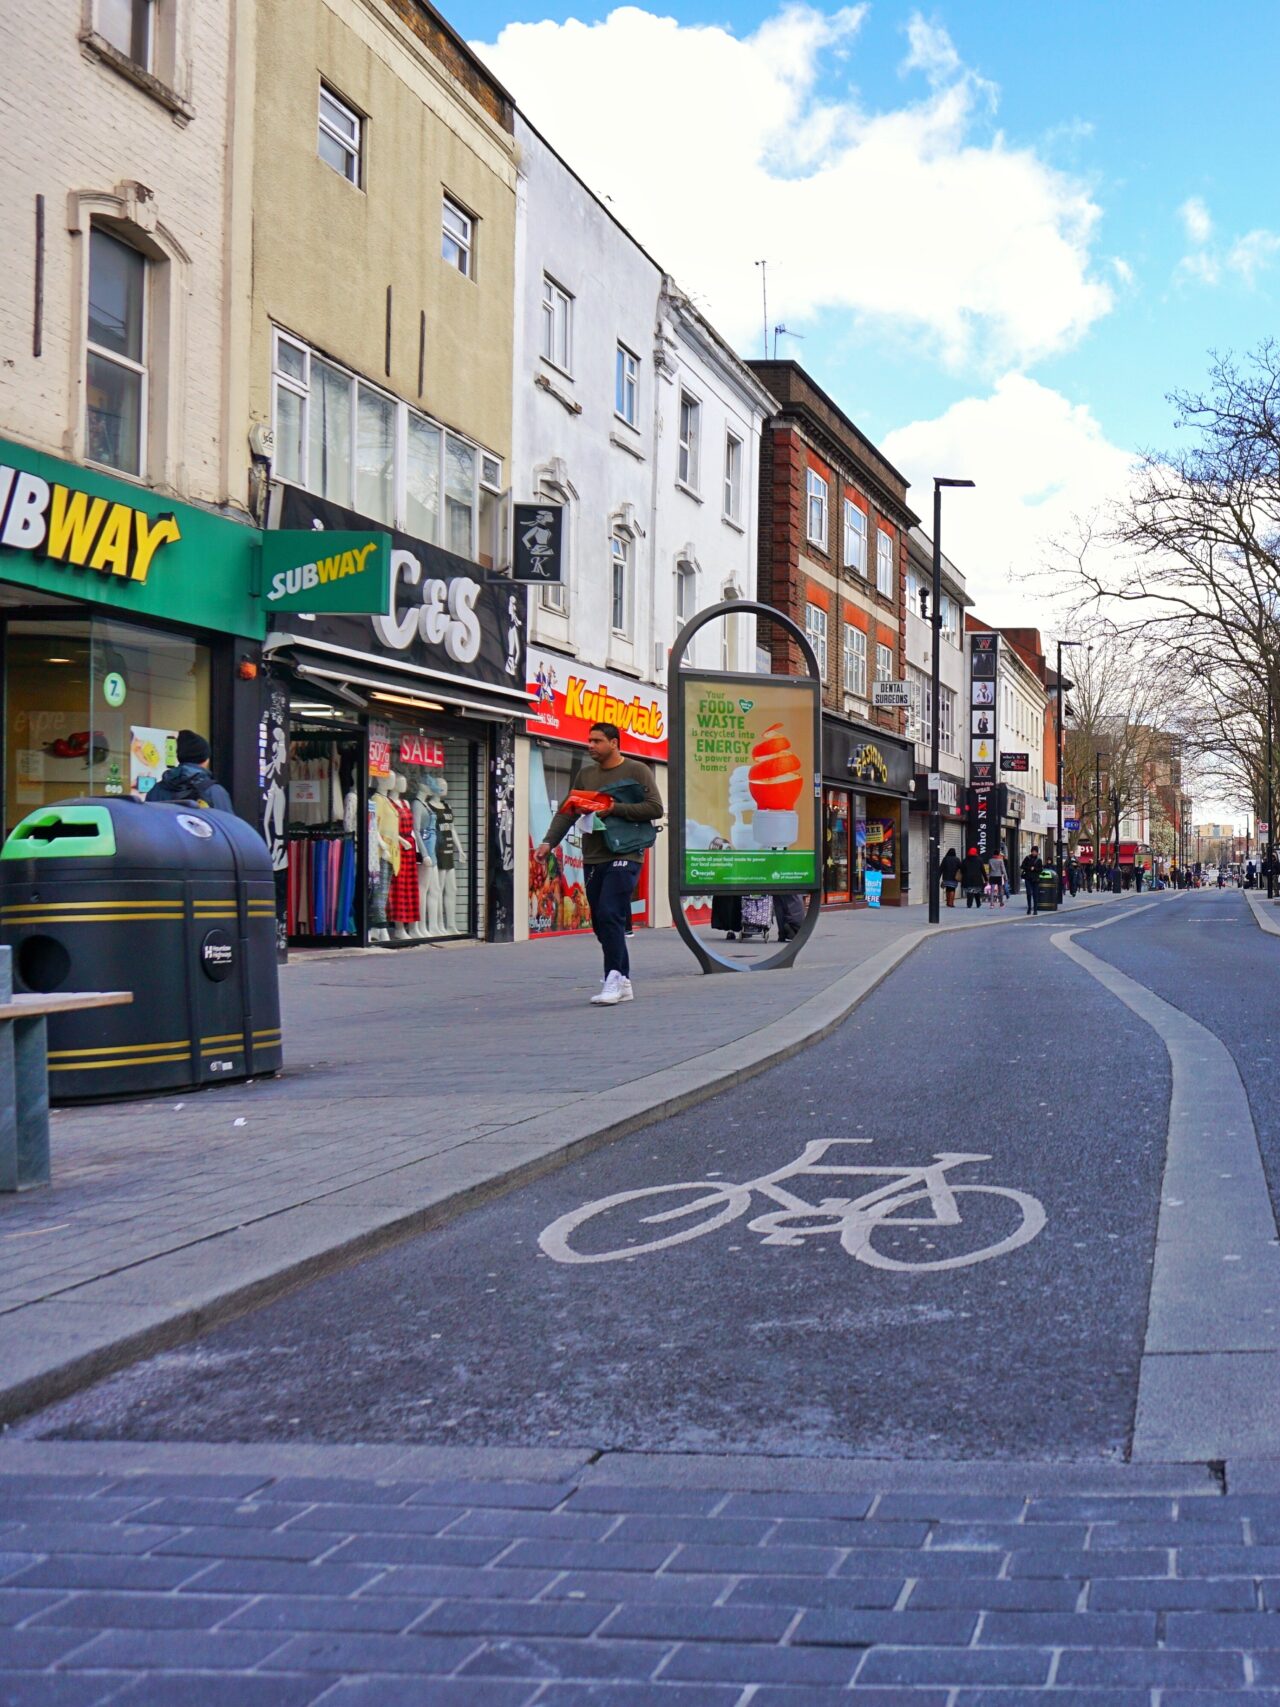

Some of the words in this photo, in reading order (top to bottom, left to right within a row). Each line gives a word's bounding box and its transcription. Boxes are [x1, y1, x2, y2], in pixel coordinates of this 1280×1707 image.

[0, 464, 182, 583] BWAY
[267, 542, 377, 601] SUBWAY
[706, 690, 725, 699] Your
[880, 683, 904, 693] DENTAL
[875, 694, 908, 704] SURGEONS
[564, 675, 664, 739] Kujawiak
[700, 700, 734, 714] FOOD
[697, 714, 745, 729] WASTE
[692, 728, 698, 737] is
[700, 728, 735, 740] recycled
[738, 731, 755, 739] into
[369, 741, 390, 763] 50%
[402, 735, 443, 765] SALE
[696, 739, 751, 754] ENERGY
[705, 754, 731, 763] power
[700, 763, 727, 772] homes
[977, 822, 988, 855] who's
